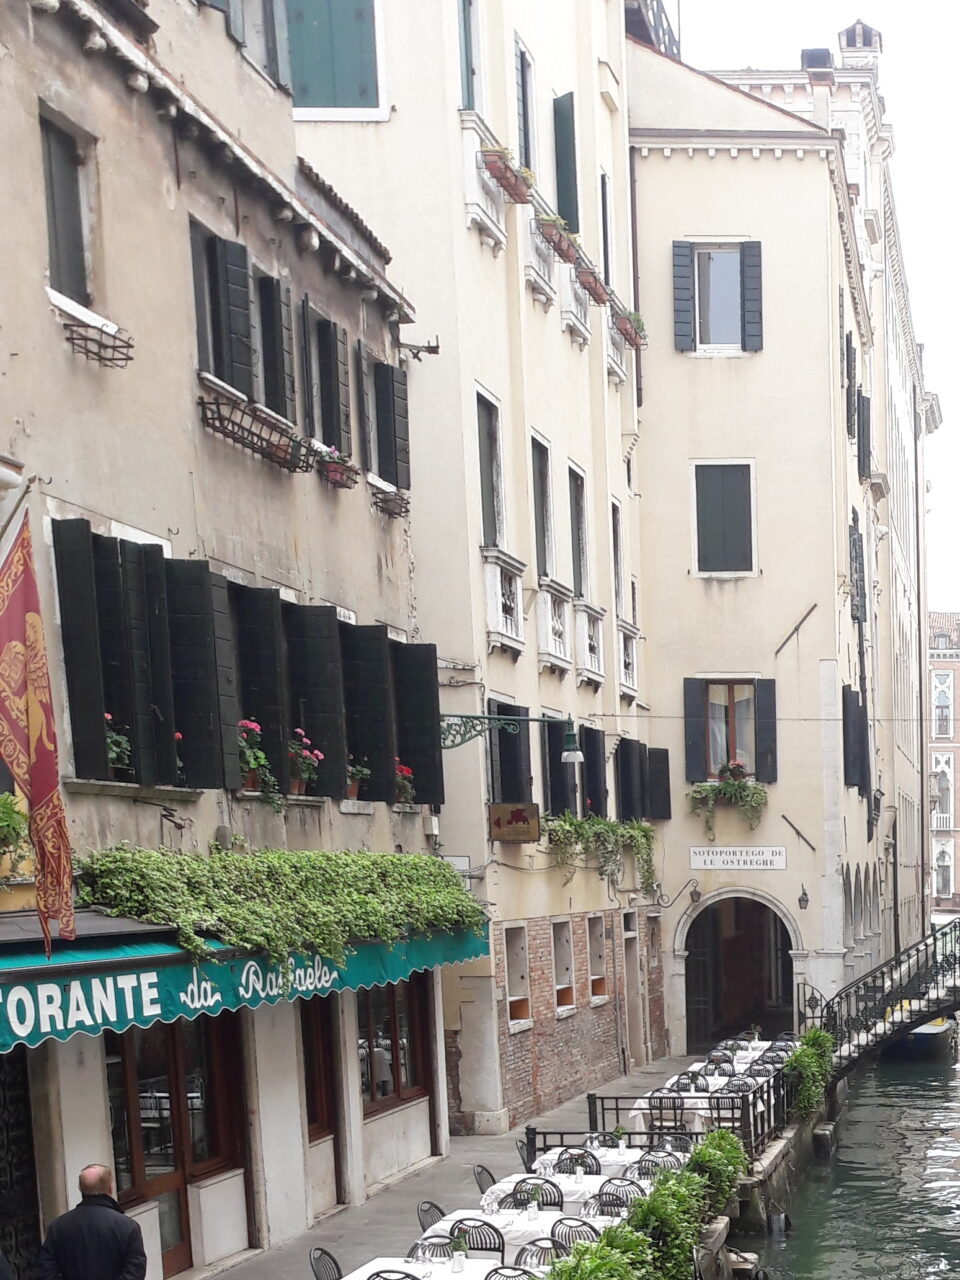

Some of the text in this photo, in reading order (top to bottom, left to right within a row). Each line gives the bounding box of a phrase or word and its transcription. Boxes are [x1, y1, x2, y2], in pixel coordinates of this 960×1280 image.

[692, 849, 784, 857] SOTOPORTEGO DE
[703, 858, 775, 867] LE OSTREGHE
[0, 971, 161, 1037] ORANTE
[179, 967, 222, 1009] da
